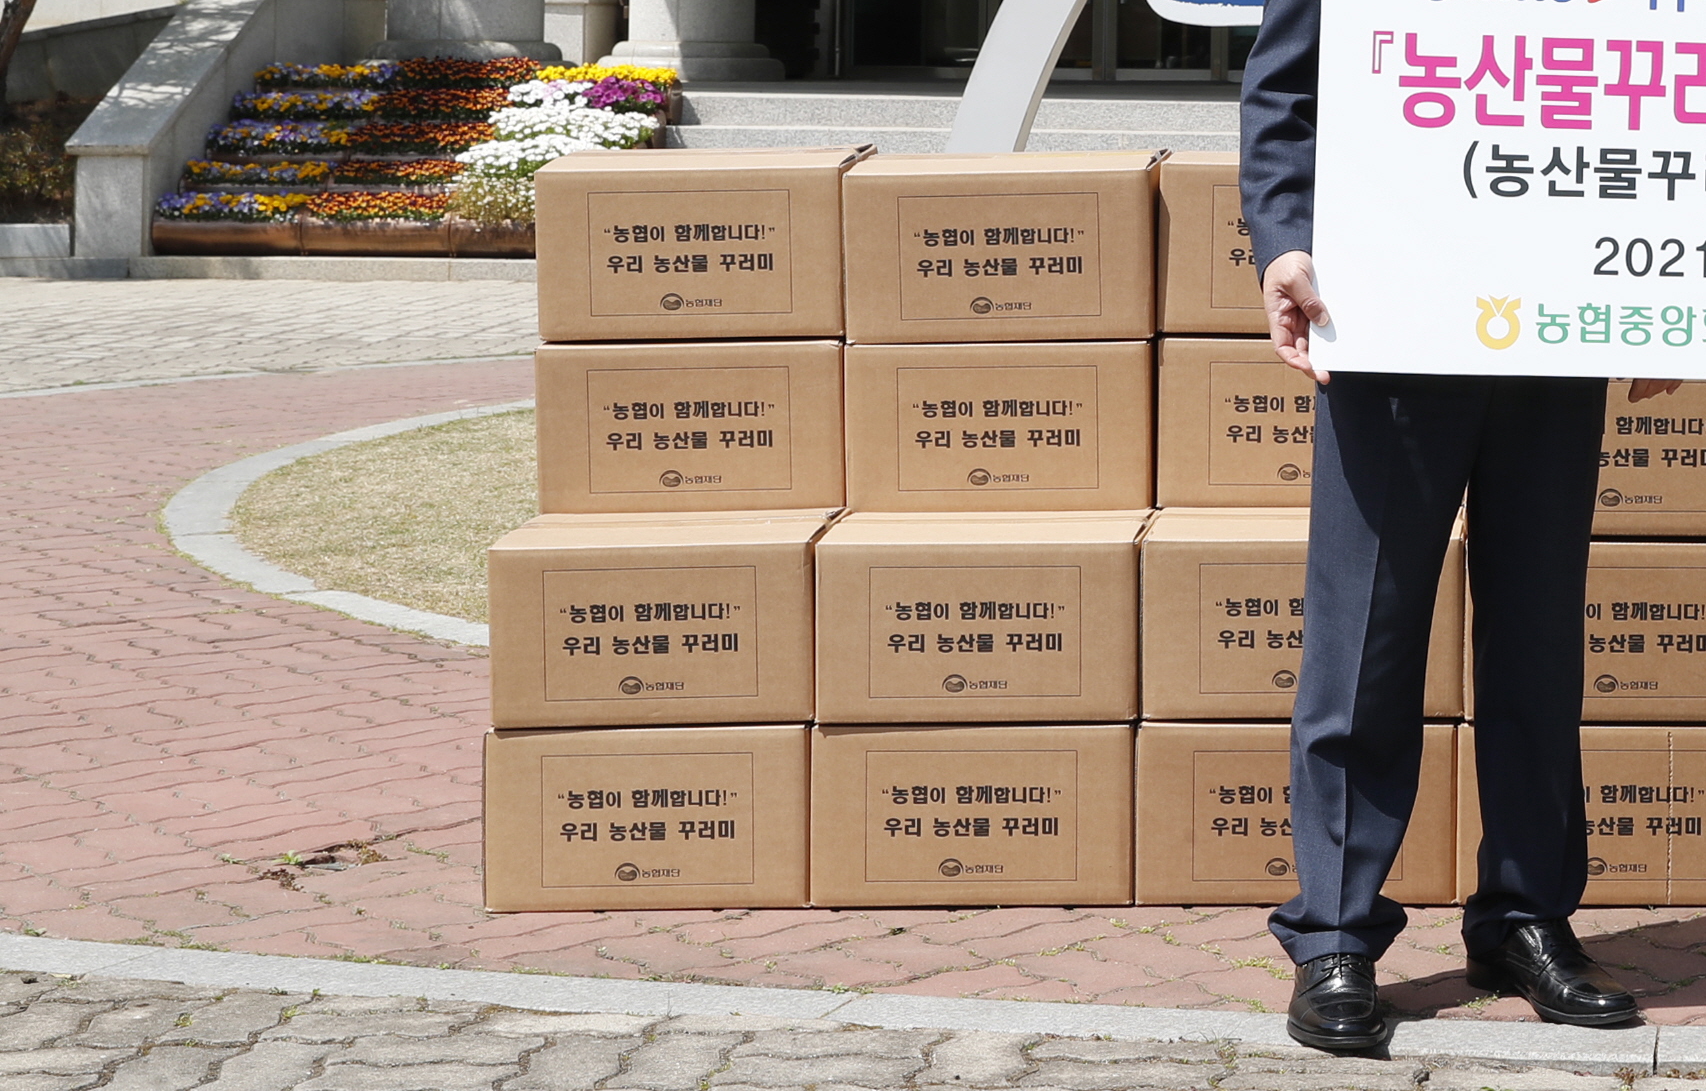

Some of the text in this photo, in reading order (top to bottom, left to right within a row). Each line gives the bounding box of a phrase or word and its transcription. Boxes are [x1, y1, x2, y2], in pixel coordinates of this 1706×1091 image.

[607, 253, 774, 273] 우리 농산물 꾸러미
[917, 256, 1083, 278] 우리 농산물 꾸러미
[606, 430, 774, 451] 우리 농산물 꾸러미
[915, 429, 1081, 449] 우리 농산물 꾸러미
[1226, 425, 1262, 443] 우리
[562, 633, 739, 656] 우리 농산물 꾸러미
[887, 633, 1063, 653] 우리 농산물 꾸러미
[1218, 630, 1255, 649] 우리
[1588, 634, 1645, 653] 농산물
[560, 820, 735, 842] 우리 농산물 꾸러미
[884, 817, 1059, 837] 우리 농산물 꾸러미
[1211, 817, 1248, 837] 우리
[1645, 817, 1702, 836] 꾸러미
